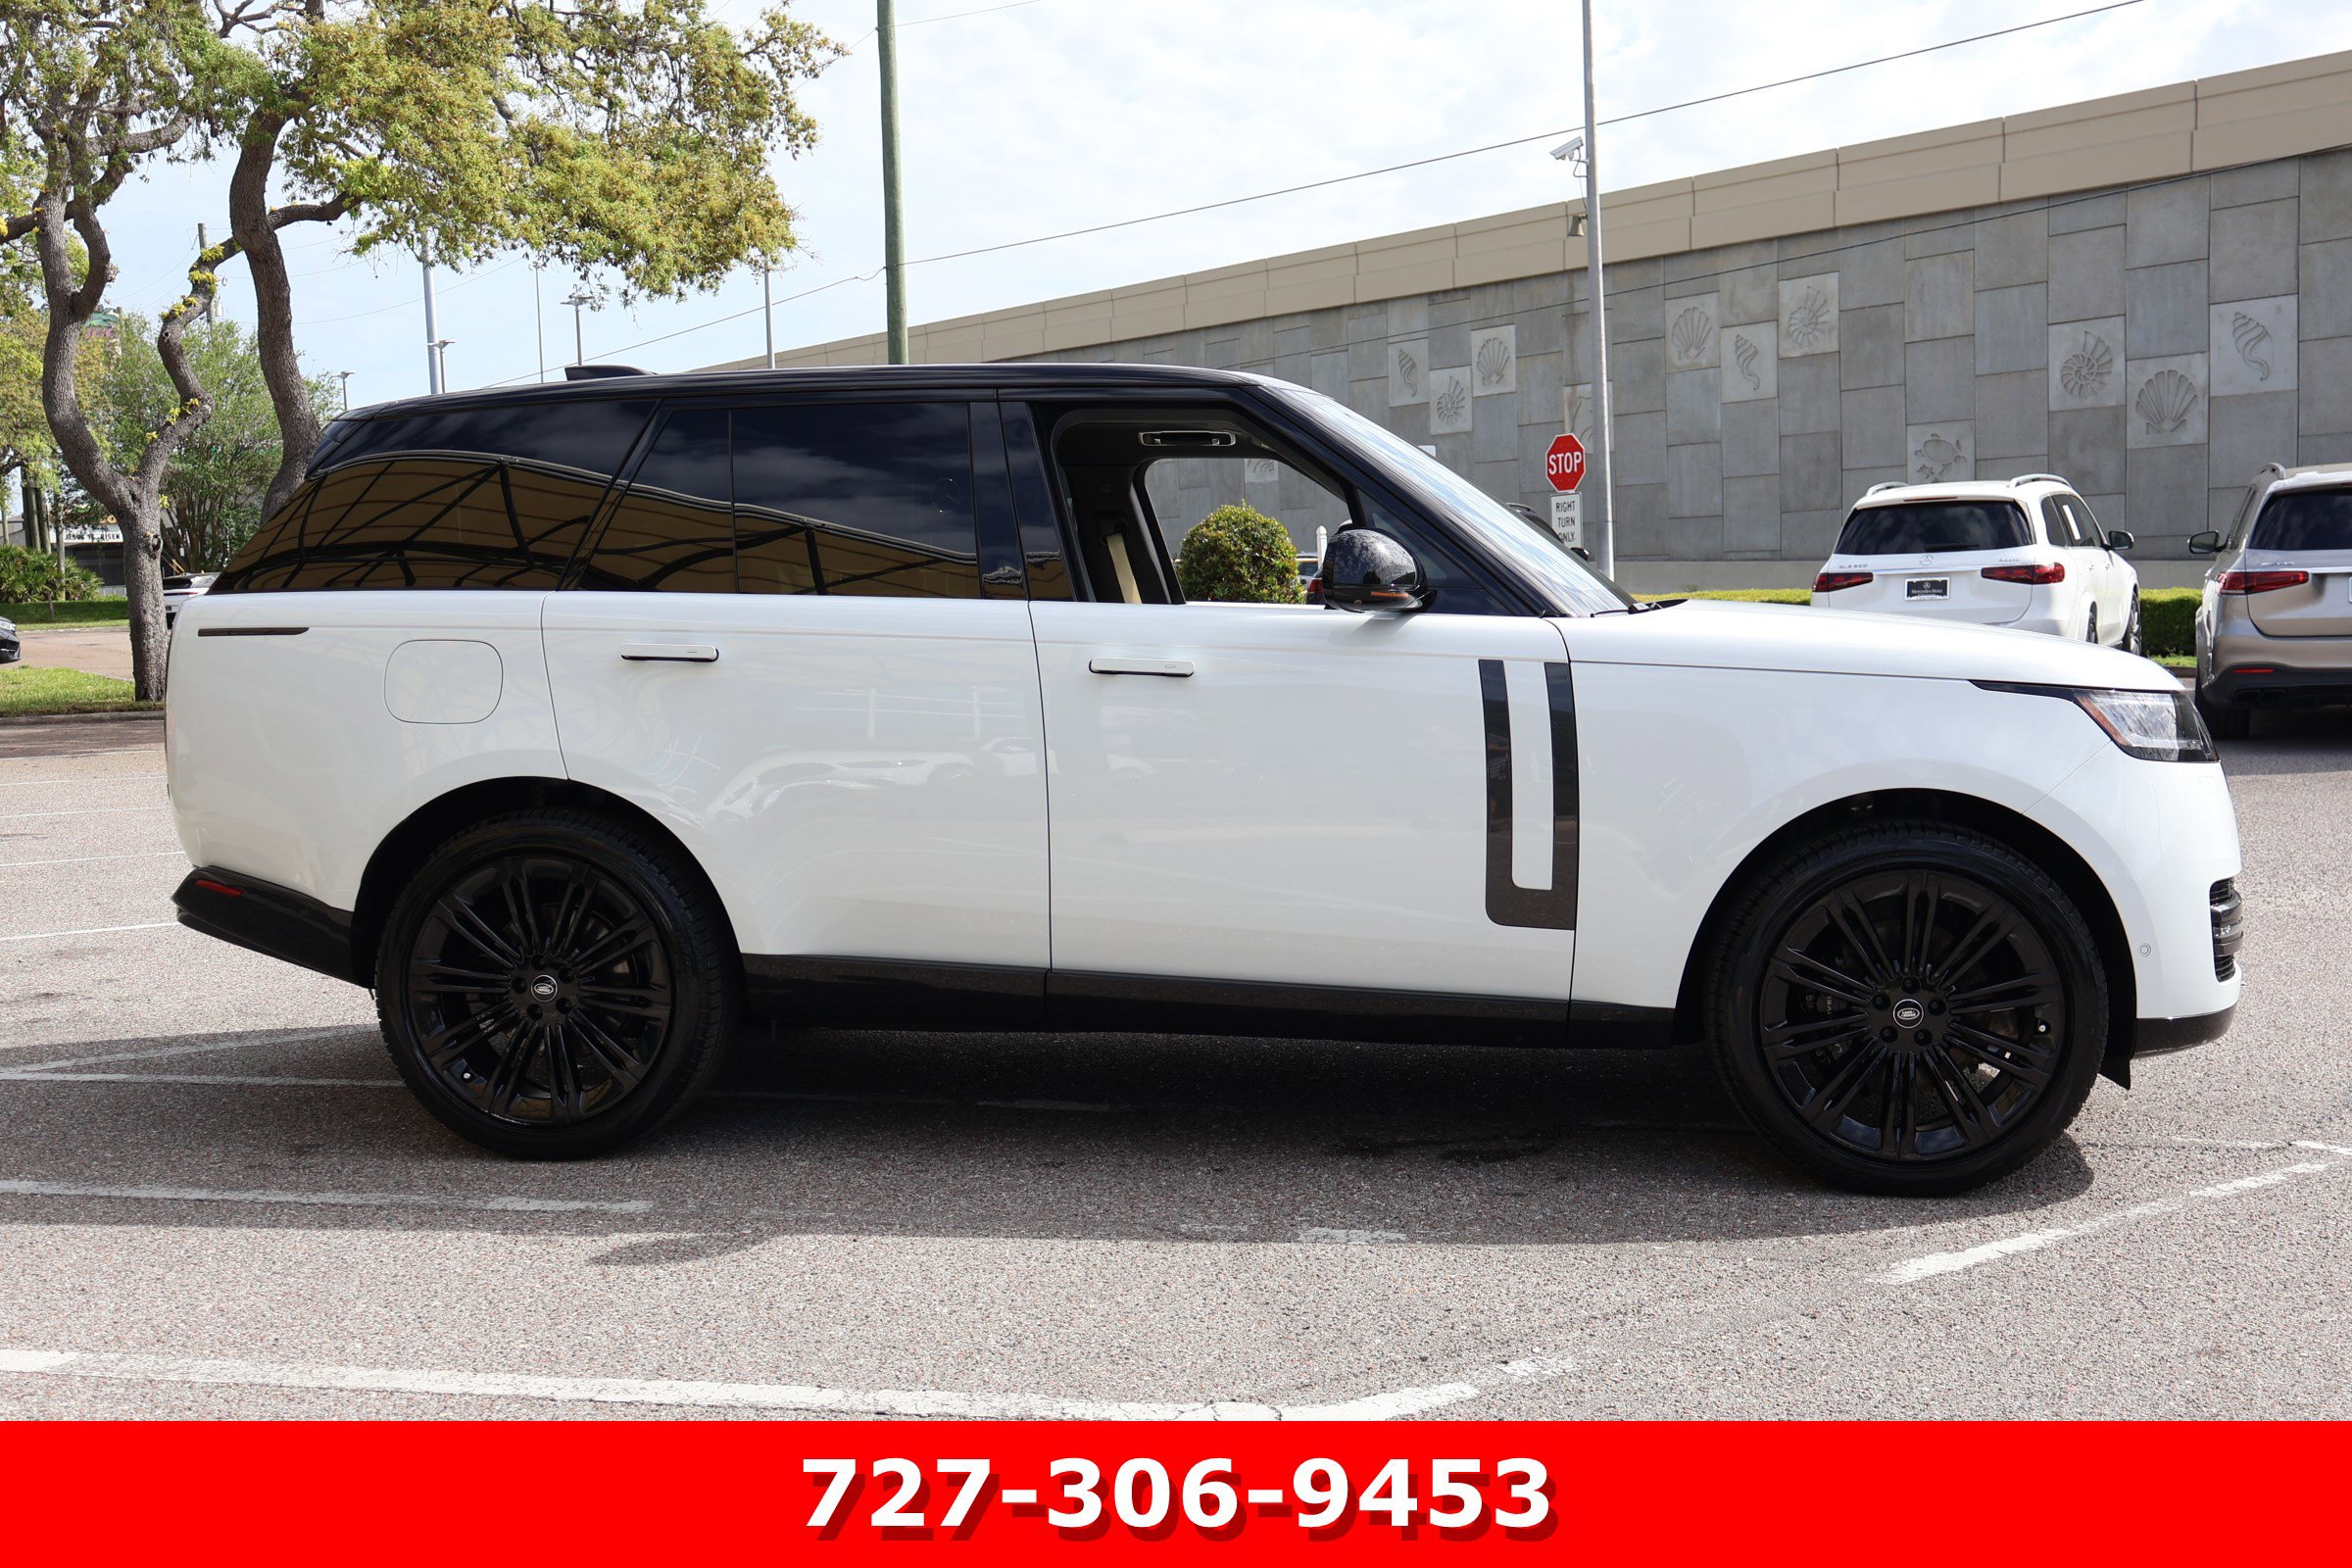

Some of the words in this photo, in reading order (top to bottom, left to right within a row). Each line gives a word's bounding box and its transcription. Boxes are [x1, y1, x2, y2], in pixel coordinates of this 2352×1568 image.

[1548, 451, 1582, 475] STOP
[1555, 500, 1576, 513] RIGHT
[1557, 515, 1576, 528] TURN
[1558, 530, 1576, 544] ONLY
